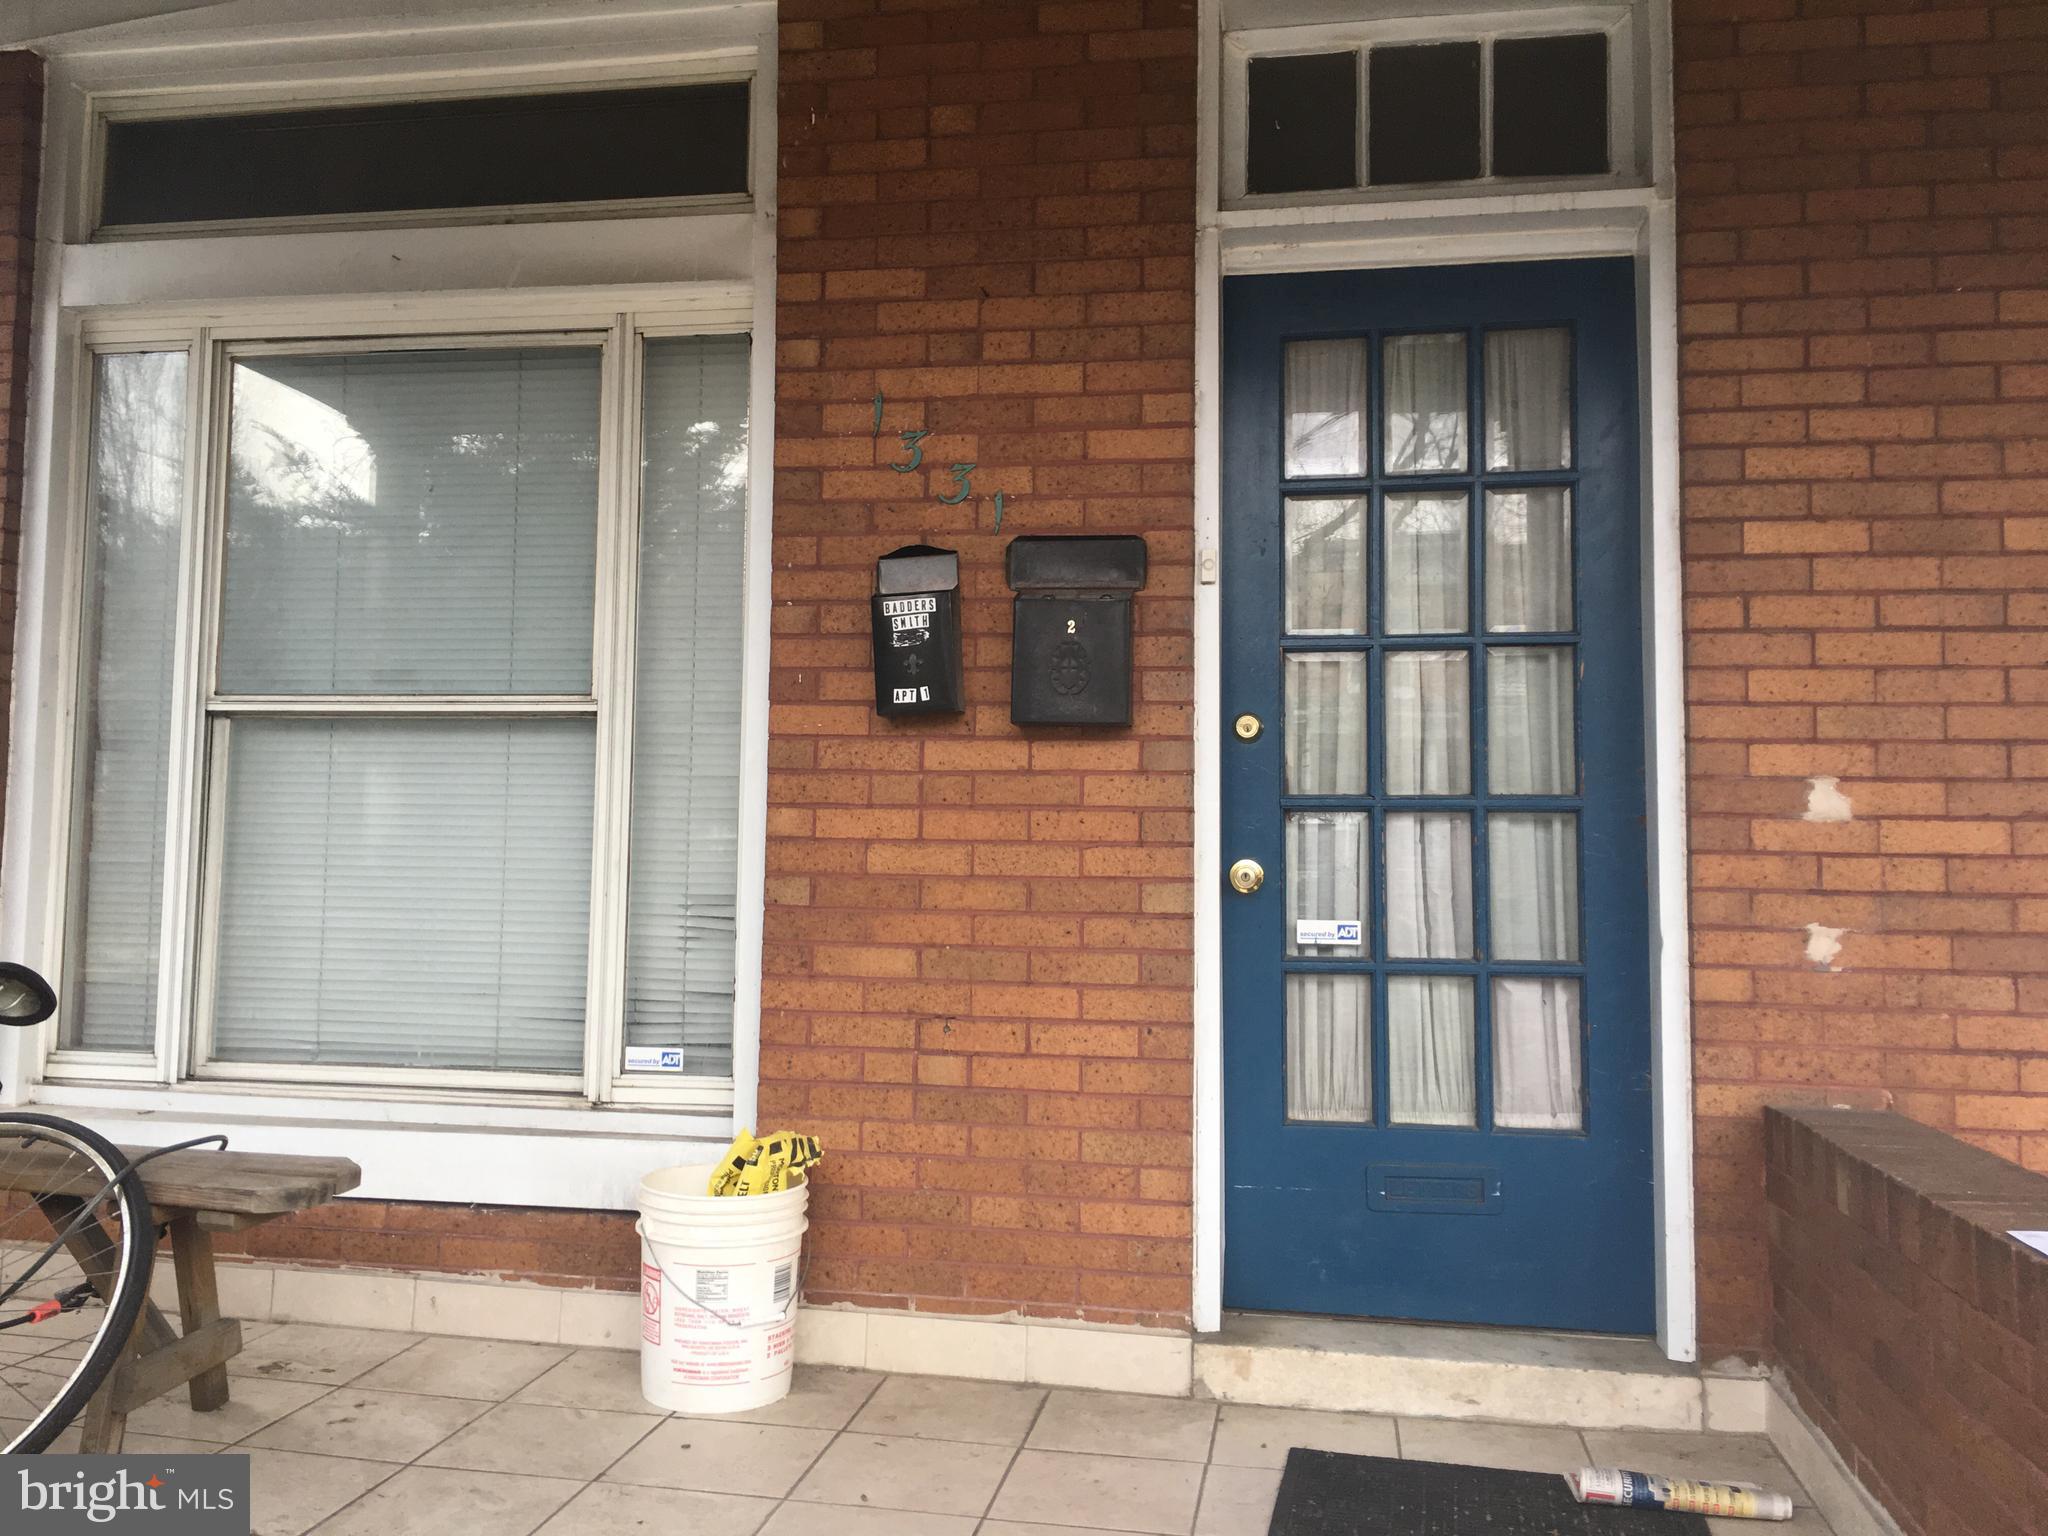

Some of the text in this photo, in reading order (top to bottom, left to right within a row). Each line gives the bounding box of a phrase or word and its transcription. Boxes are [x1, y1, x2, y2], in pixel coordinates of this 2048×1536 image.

[884, 599, 935, 614] BADDERS
[893, 615, 928, 630] SMITH
[1067, 619, 1076, 634] 2
[895, 690, 915, 702] APT
[1338, 926, 1358, 939] ADT
[662, 1052, 680, 1067] ADT
